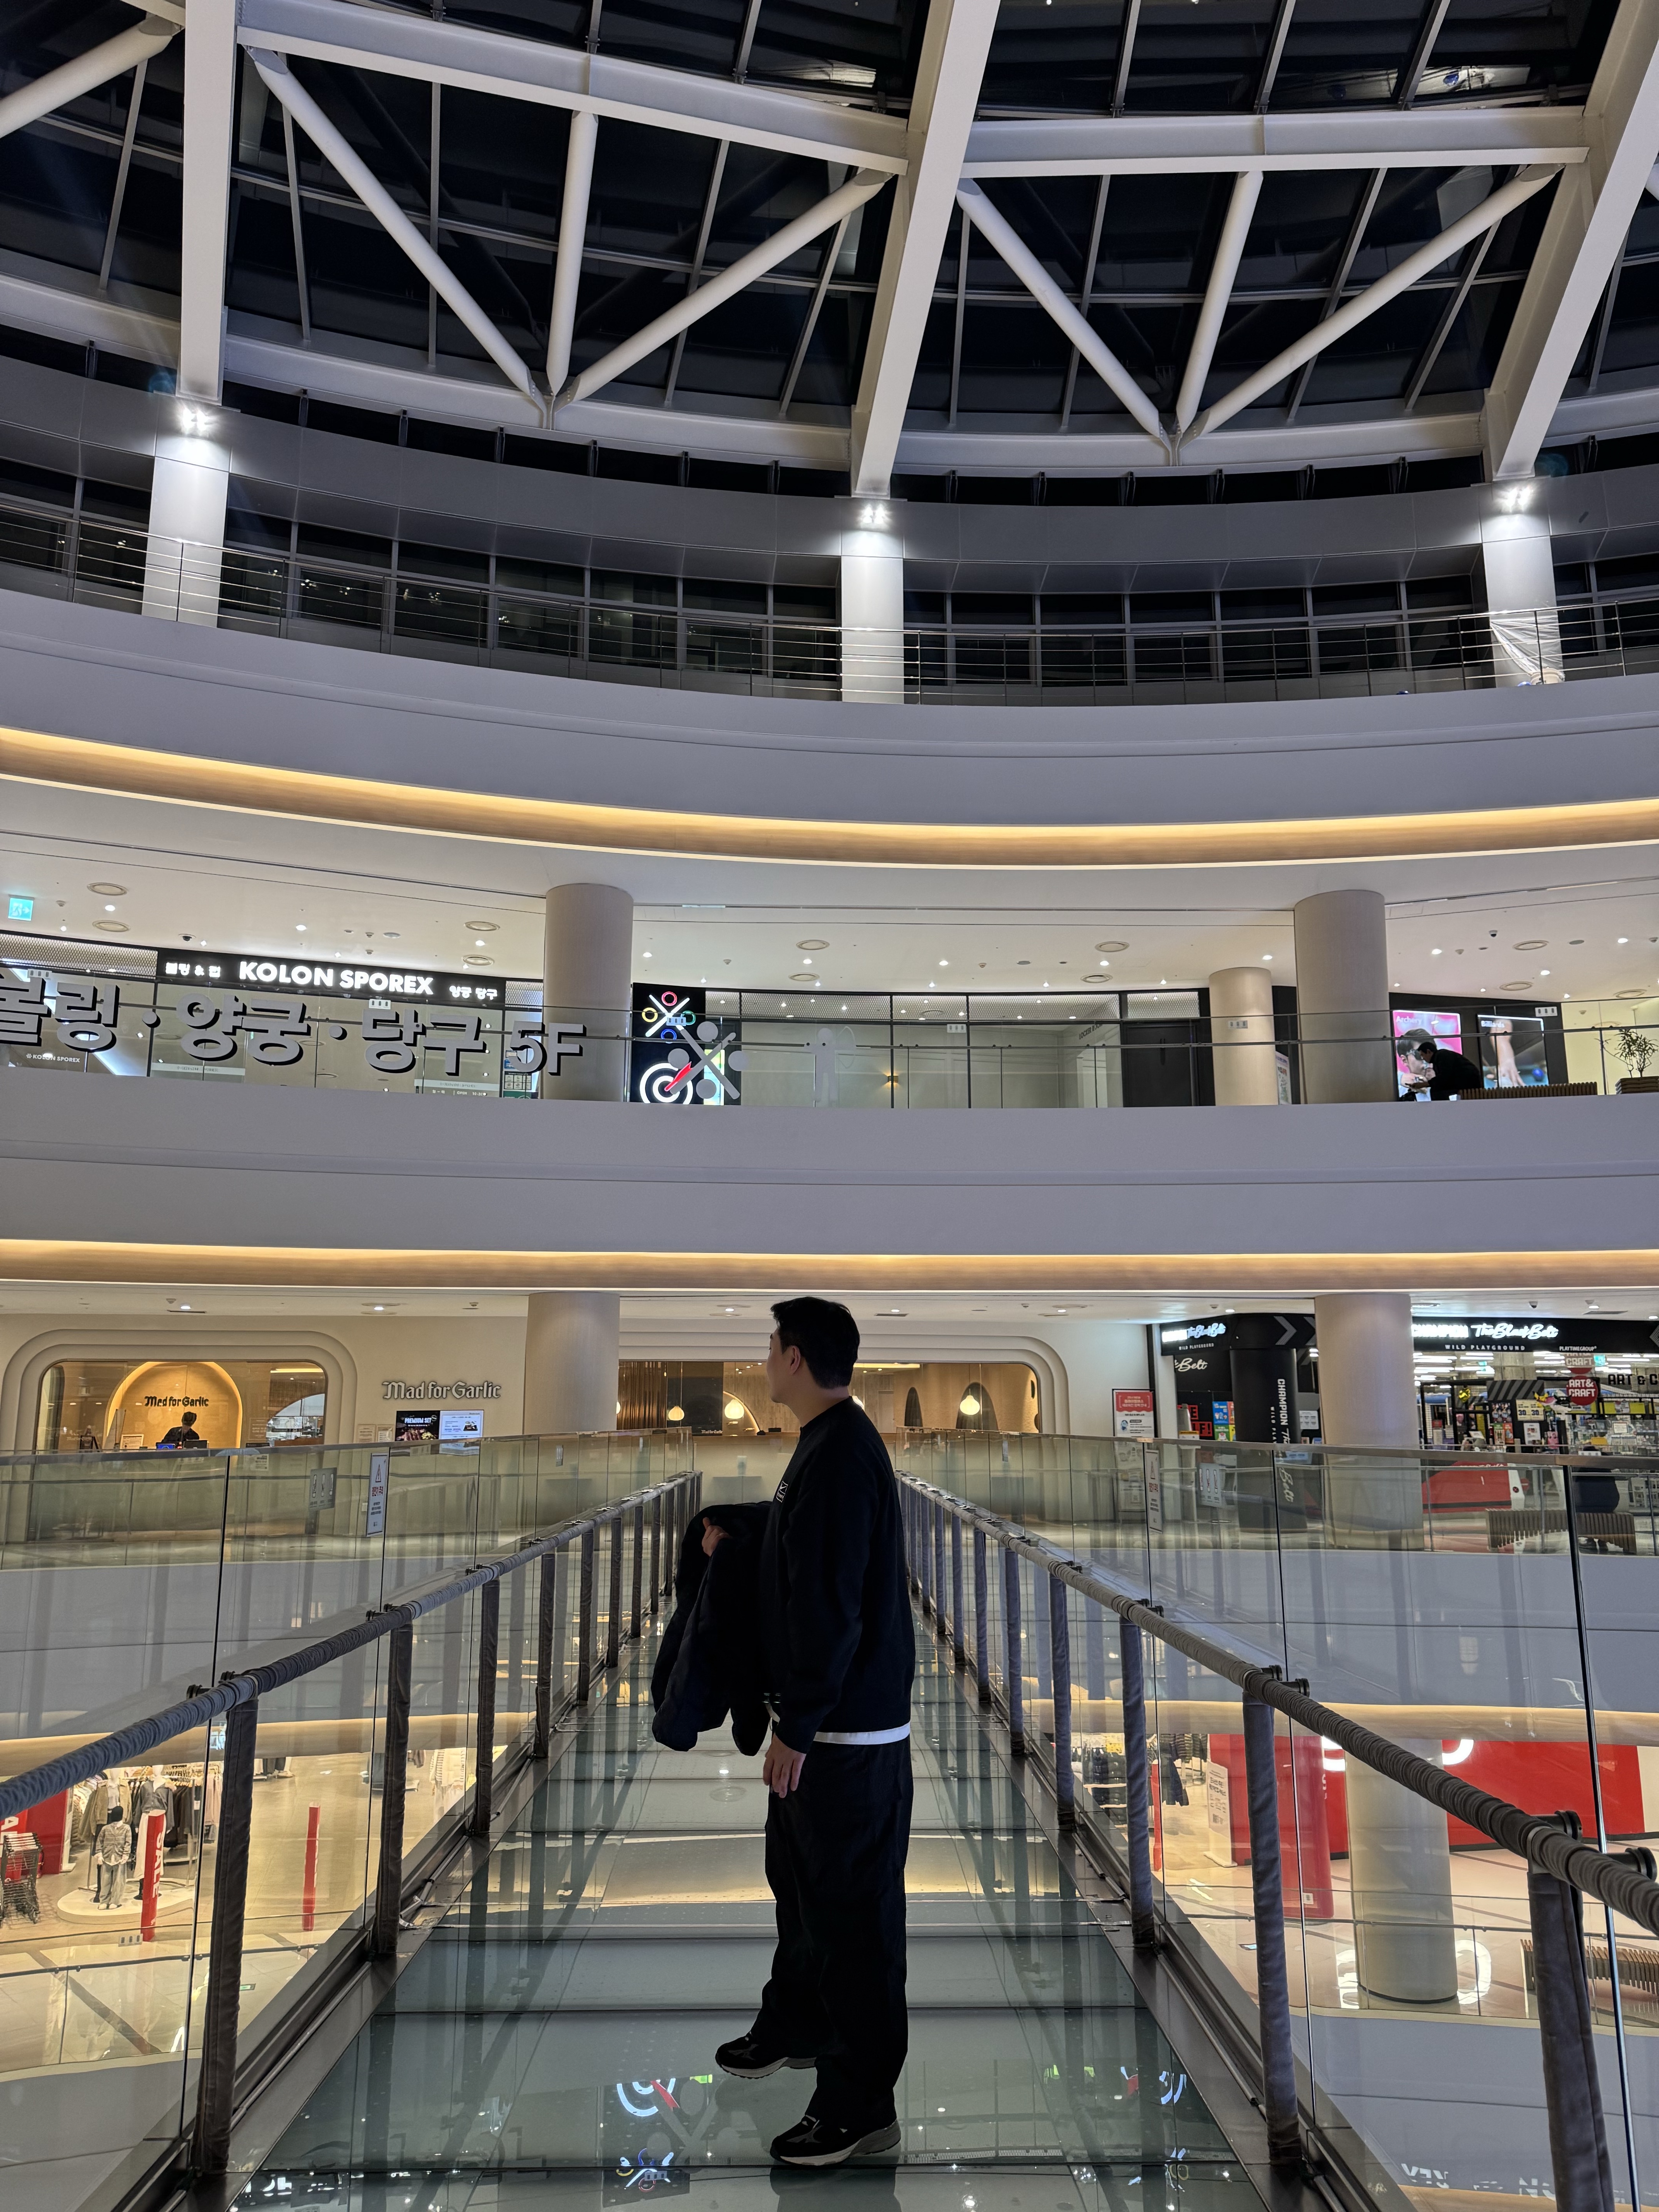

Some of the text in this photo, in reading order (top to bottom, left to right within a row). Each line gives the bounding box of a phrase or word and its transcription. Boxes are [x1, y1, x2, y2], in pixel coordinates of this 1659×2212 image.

[240, 961, 433, 994] KOLON SPOREX
[449, 985, 497, 1000] 양궁 당구
[1396, 1016, 1422, 1025] Archery
[510, 1020, 587, 1076] 5F
[1608, 1374, 1632, 1385] ART
[382, 1381, 501, 1399] Mad for Garlic
[1569, 1389, 1596, 1397] CRAFT
[168, 1396, 181, 1407] for
[182, 1396, 209, 1407] Garlic
[1278, 1379, 1288, 1425] CHAMPION
[152, 1832, 163, 1898] SALE
